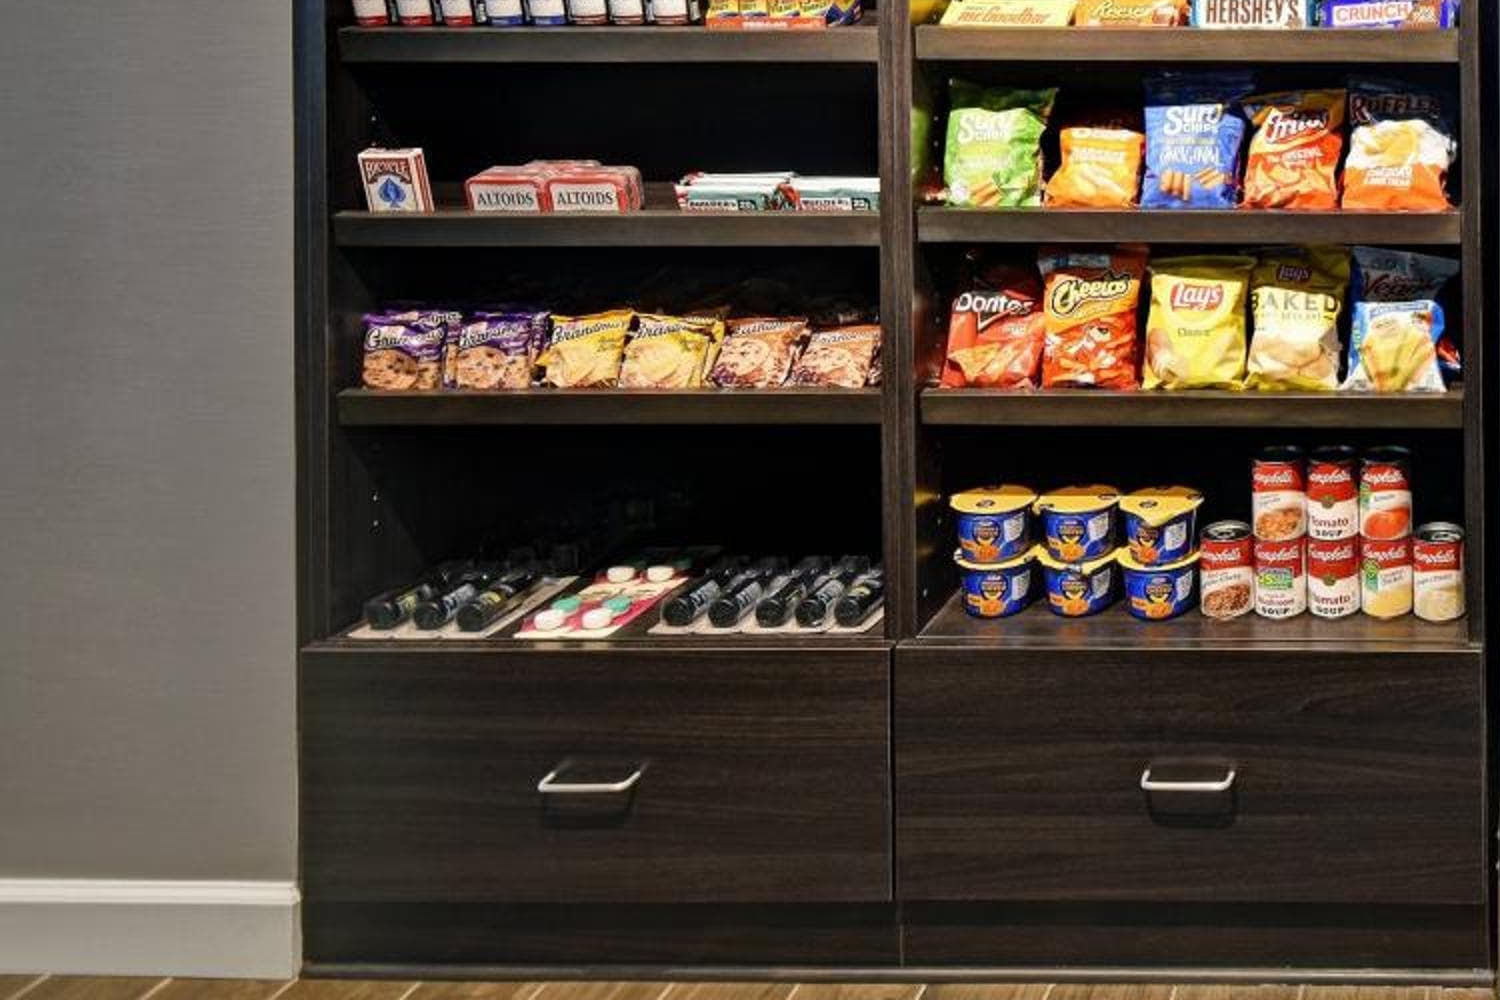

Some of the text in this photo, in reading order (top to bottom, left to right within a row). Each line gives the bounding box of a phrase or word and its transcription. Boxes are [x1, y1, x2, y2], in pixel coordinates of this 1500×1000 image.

[1335, 2, 1412, 23] CRUNCH
[477, 190, 534, 206] ALTOIDS
[557, 190, 614, 206] ALTOIDS
[955, 292, 1034, 315] Doritos
[1051, 278, 1131, 315] Cheetos
[1173, 282, 1222, 310] Lay's
[1252, 292, 1338, 312] BAKED
[1311, 515, 1349, 528] Tomato
